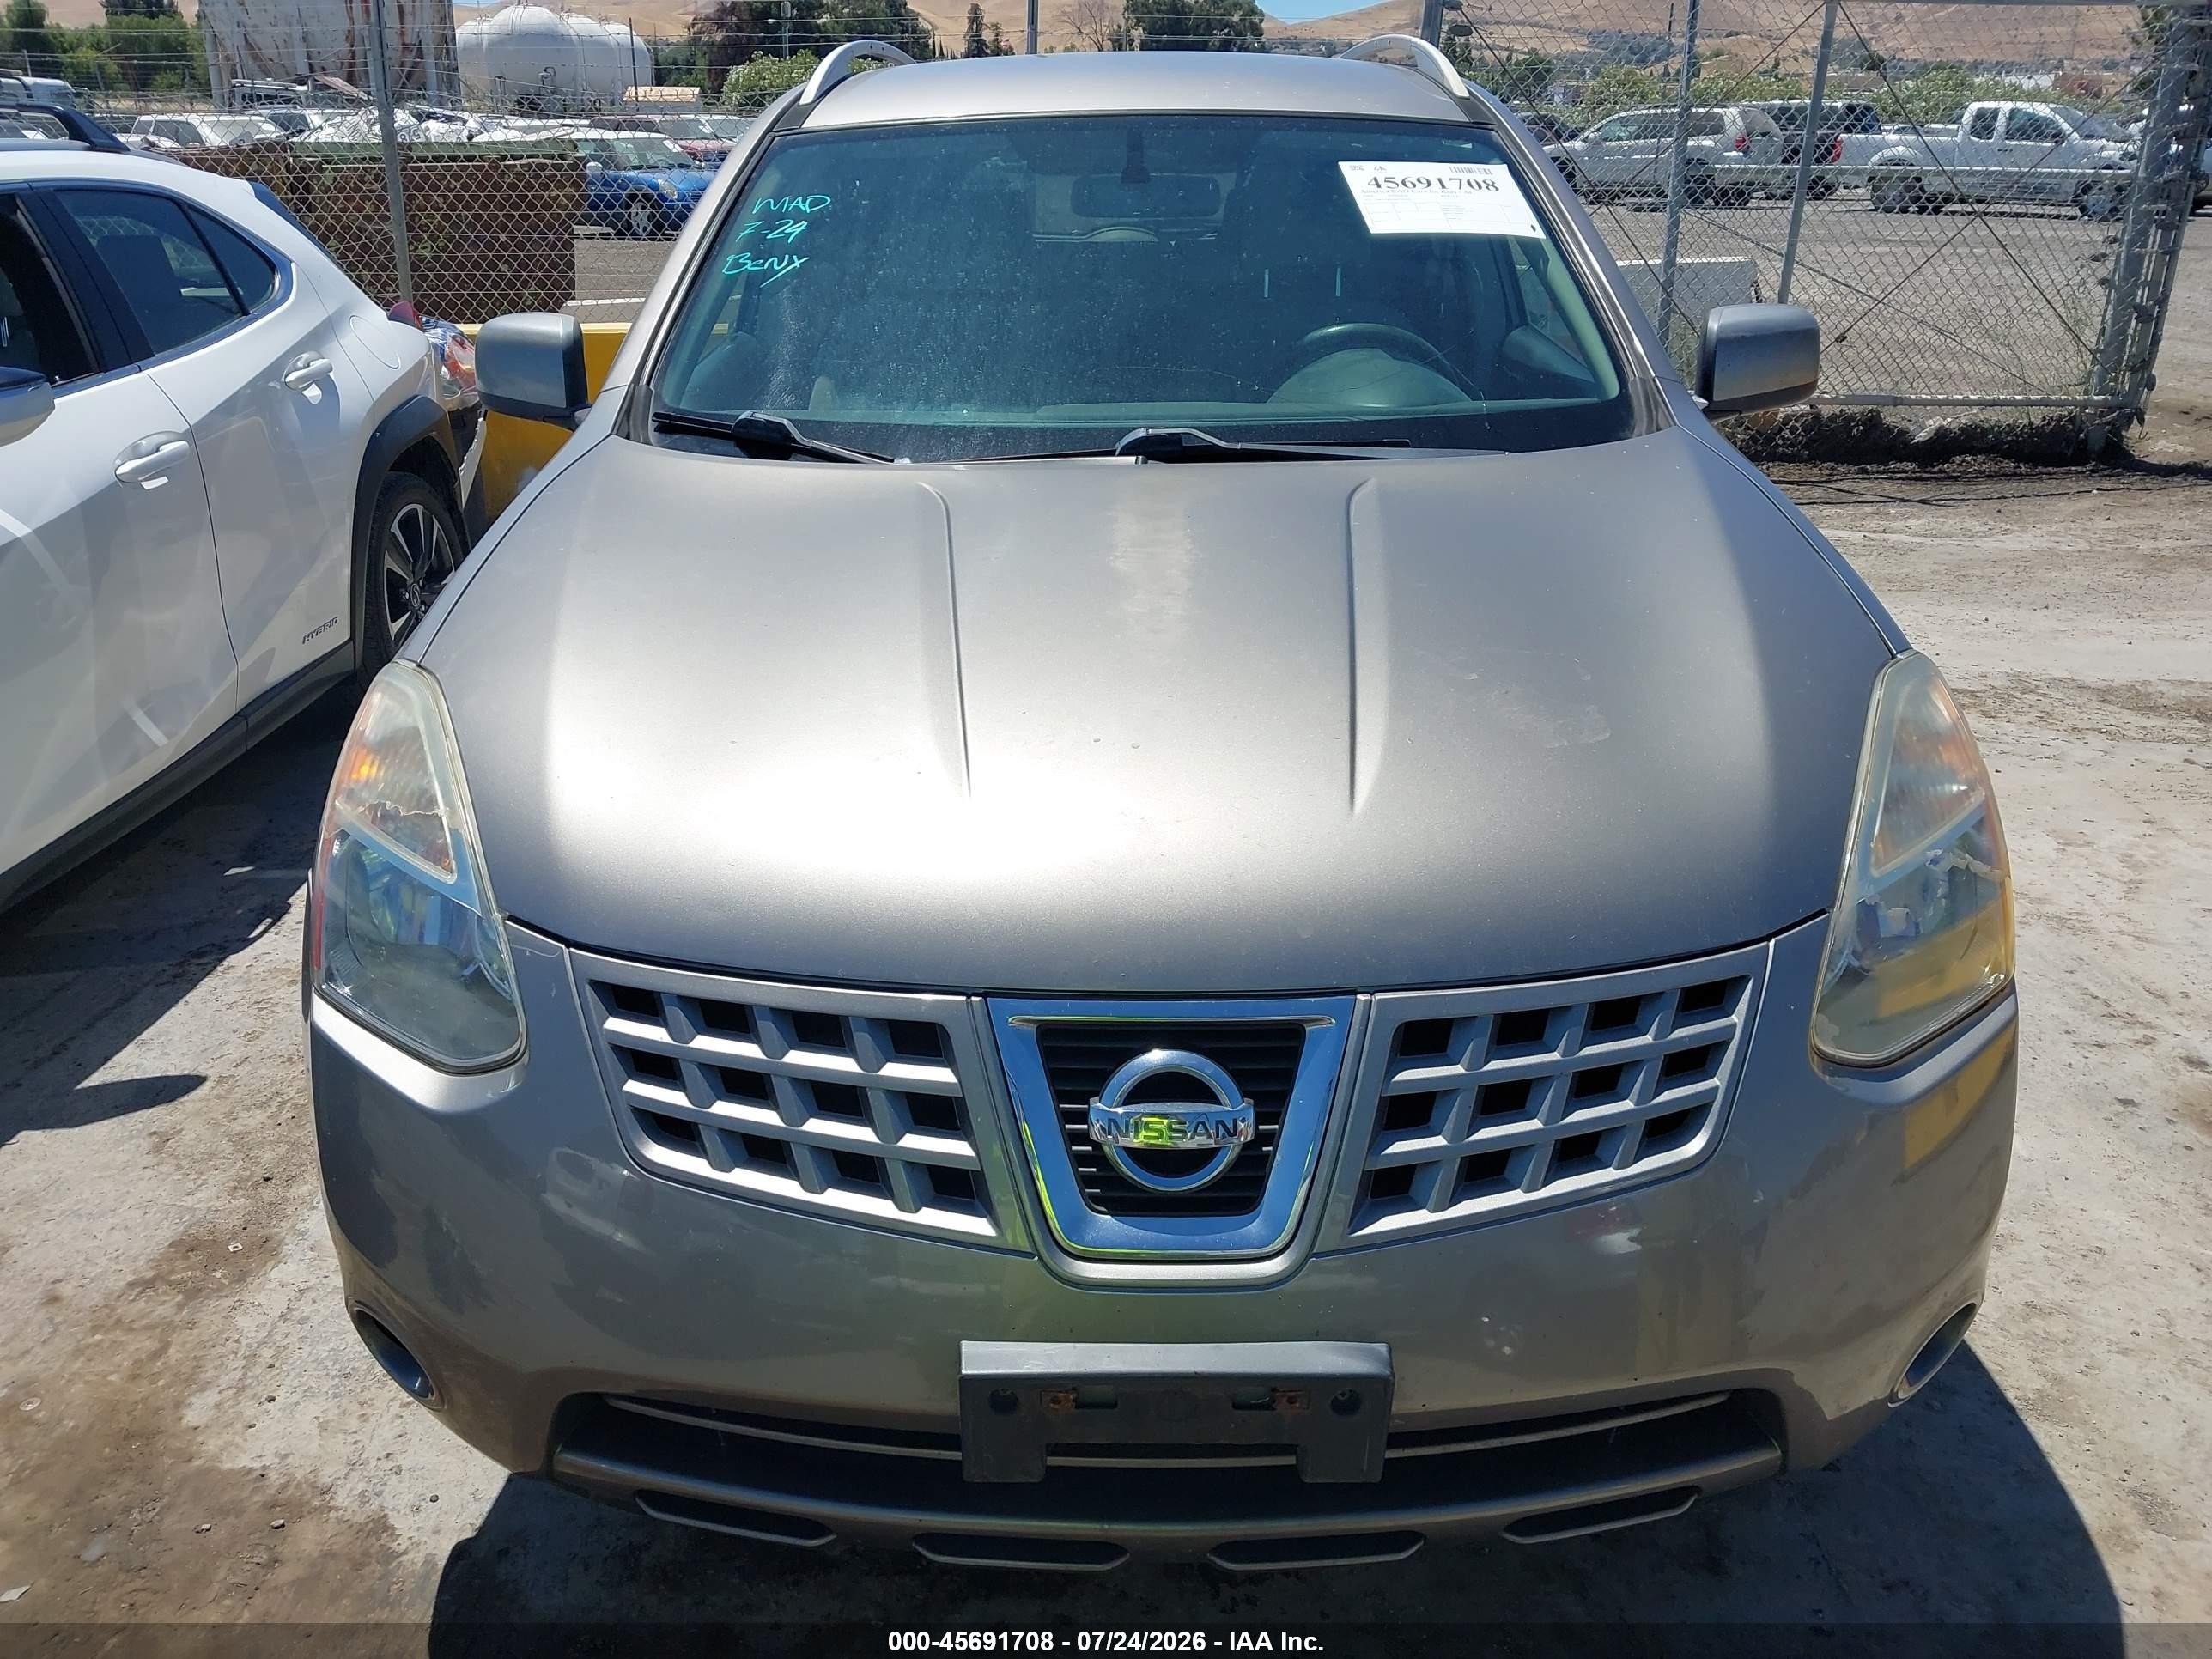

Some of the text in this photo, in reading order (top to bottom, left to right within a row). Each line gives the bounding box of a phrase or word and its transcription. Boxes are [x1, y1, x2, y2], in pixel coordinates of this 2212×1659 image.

[1368, 176, 1500, 192] 45691708
[752, 195, 831, 215] MAD
[1106, 1115, 1238, 1142] NISSAN
